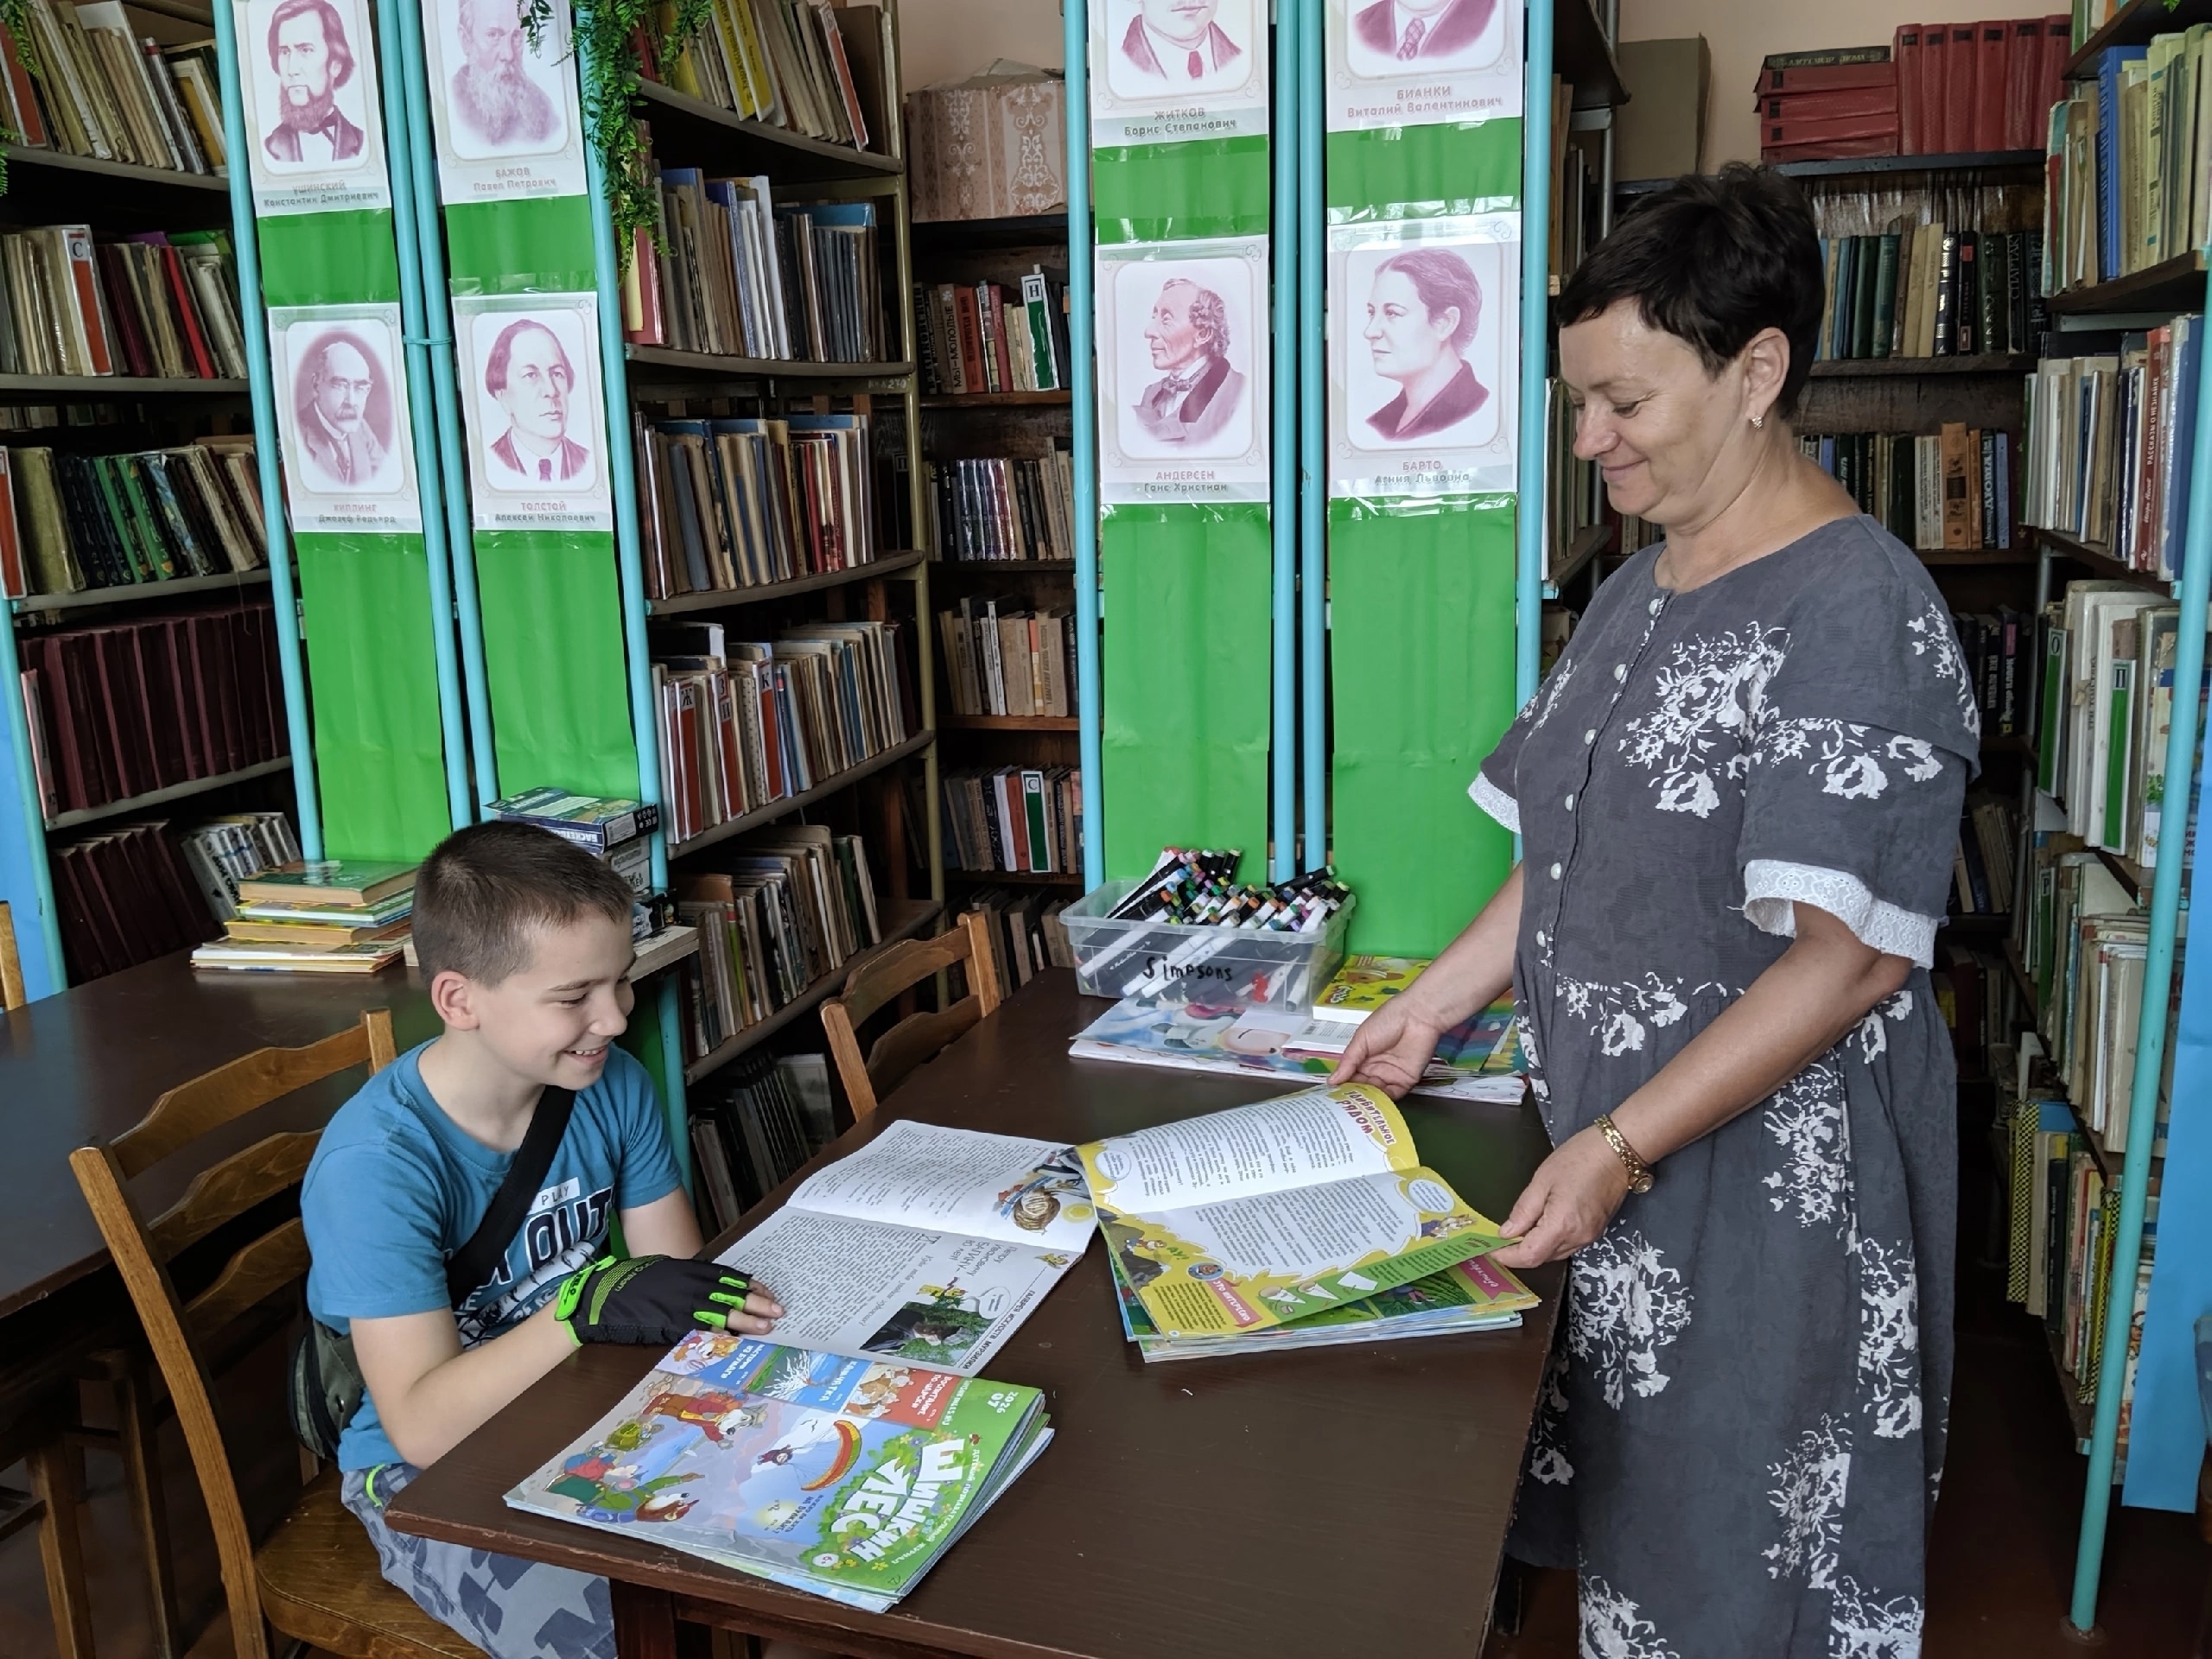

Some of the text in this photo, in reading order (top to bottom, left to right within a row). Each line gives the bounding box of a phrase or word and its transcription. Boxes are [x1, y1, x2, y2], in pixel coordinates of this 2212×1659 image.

[1396, 85, 1452, 101] БИАНКИ
[1154, 105, 1206, 122] ЖИТКОВ
[1347, 93, 1503, 119] Виталий Валентинович
[1124, 117, 1237, 137] Борис Степанович
[494, 166, 531, 178] БАЖОВ
[291, 180, 347, 193] УШИНСКИЙ
[473, 177, 556, 193] Павел Петрович
[263, 190, 380, 208] Константин Дмитриевич
[72, 241, 84, 259] С
[1027, 281, 1040, 298] Н
[2150, 376, 2160, 416] НЕЗНАЙКЕ
[2146, 423, 2157, 466] РАССКАЗЫ
[1402, 459, 1442, 472] БАРТО
[1154, 468, 1216, 482] АНДЕРСЕН
[1374, 471, 1471, 486] Агния Львовна
[1983, 455, 1995, 510] ДЮМА
[1143, 480, 1228, 493] Ганс Христиан
[333, 502, 378, 513] КИПЛИНГ
[520, 499, 568, 513] ТОЛСТОЙ
[318, 513, 397, 525] Джозеф Редьярд
[494, 512, 597, 524] Алексей Николаевич
[761, 672, 771, 690] К
[680, 688, 693, 707] Ж
[1026, 777, 1039, 792] С
[1142, 956, 1233, 982] Simpsons
[1335, 1099, 1375, 1135] РЯДОМ
[541, 1185, 570, 1206] PLAY
[525, 1182, 615, 1273] OUT
[1222, 1291, 1251, 1321] ИНТЕРЕСНО
[818, 1360, 858, 1402] КАМЧАТКА
[987, 1392, 1005, 1408] 07
[996, 1390, 1020, 1414] 2026
[830, 1456, 913, 1533] ЛЕС
[849, 1438, 965, 1563] ШИШКИН
